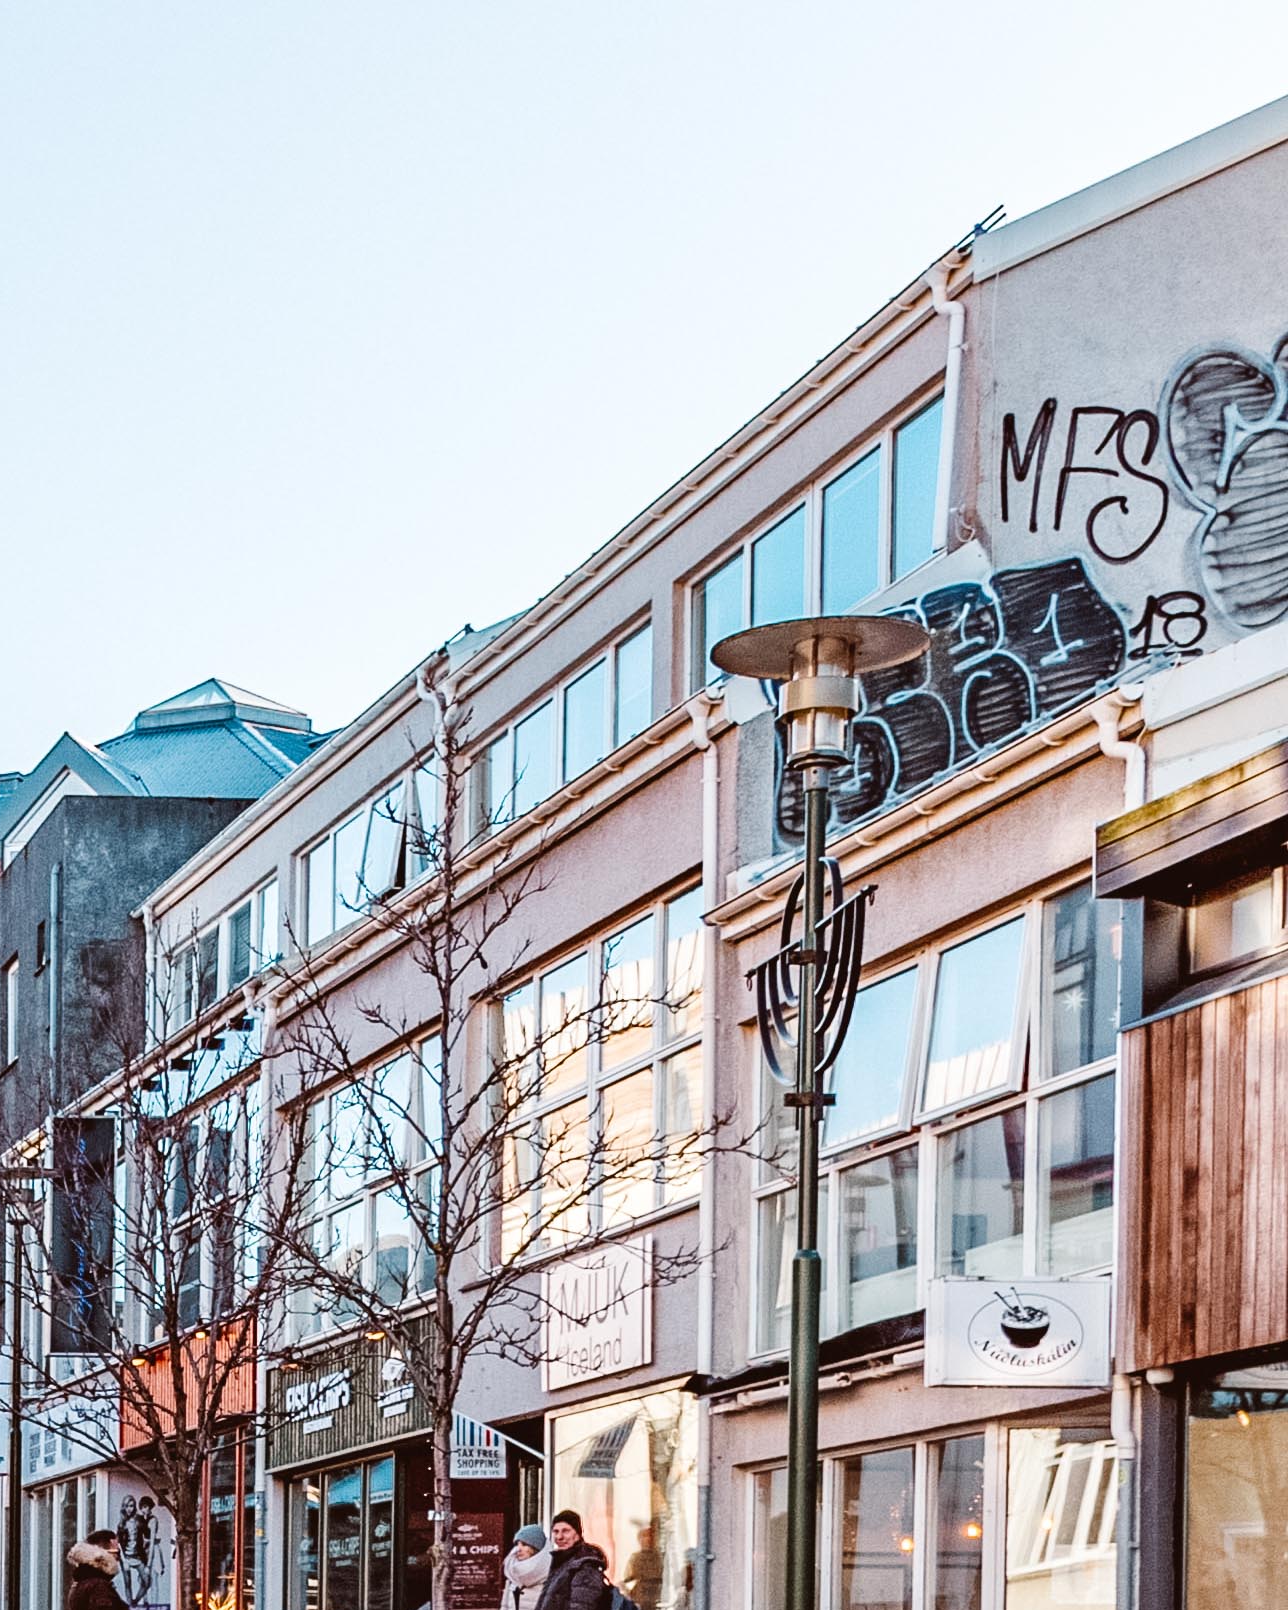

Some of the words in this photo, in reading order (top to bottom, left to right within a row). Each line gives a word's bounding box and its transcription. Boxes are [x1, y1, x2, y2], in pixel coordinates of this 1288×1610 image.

[1000, 397, 1168, 566] MFS
[565, 1327, 623, 1380] Iceland
[457, 1448, 474, 1458] TAX
[477, 1449, 499, 1458] FREE
[456, 1459, 500, 1469] SHOPPING
[469, 1544, 500, 1555] CHIPS
